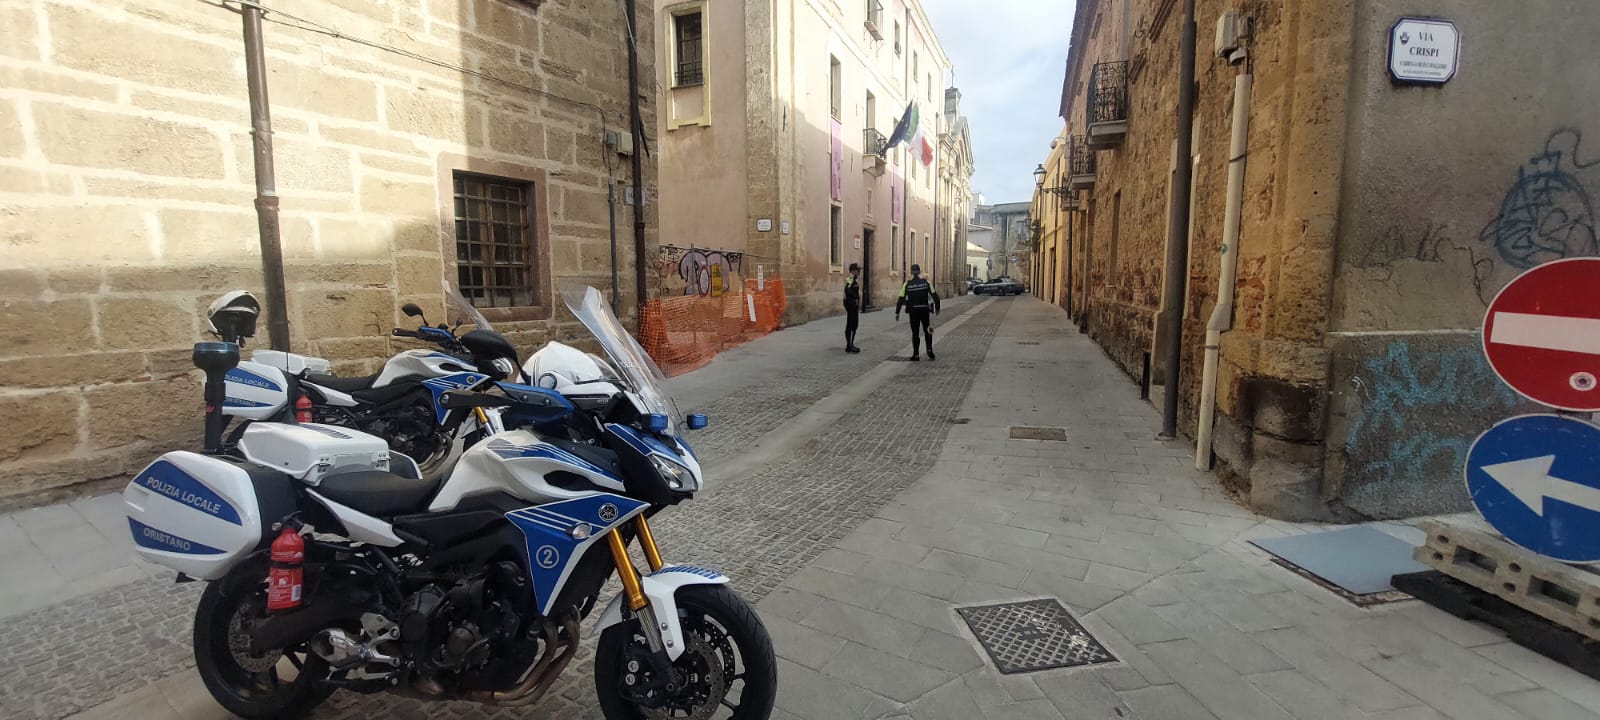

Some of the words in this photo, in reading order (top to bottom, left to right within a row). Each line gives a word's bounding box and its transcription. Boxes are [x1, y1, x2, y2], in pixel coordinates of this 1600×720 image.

[1419, 31, 1434, 42] VIA
[1409, 46, 1440, 57] CRISPI
[245, 378, 269, 388] LOCALE
[146, 476, 180, 499] POLIZIA
[181, 491, 222, 514] LOCALE
[143, 527, 191, 551] ORISTANO
[543, 548, 553, 565] 2
